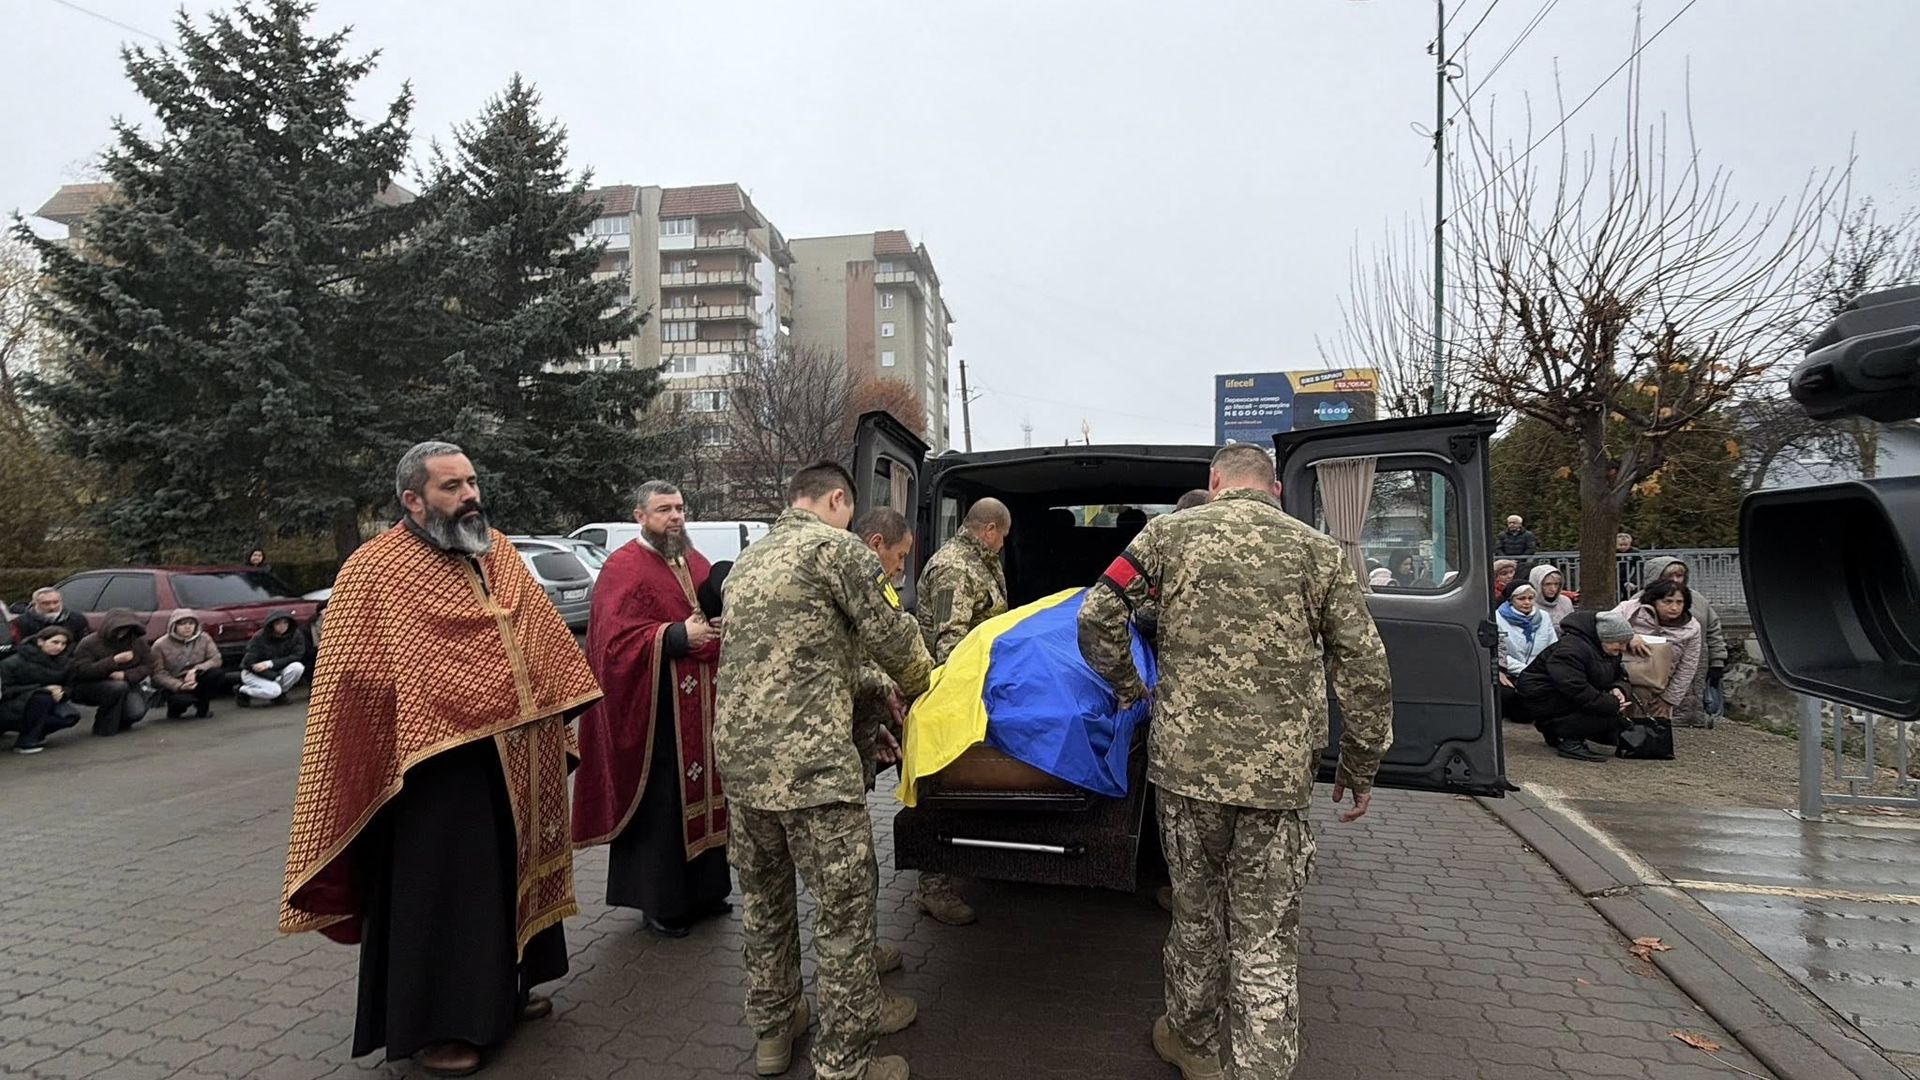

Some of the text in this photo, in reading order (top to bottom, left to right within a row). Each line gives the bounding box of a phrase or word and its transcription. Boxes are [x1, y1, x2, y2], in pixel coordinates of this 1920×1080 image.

[1225, 378, 1254, 388] lifecell
[1224, 409, 1265, 417] MEGOGO
[1313, 407, 1354, 415] MEGOGO
